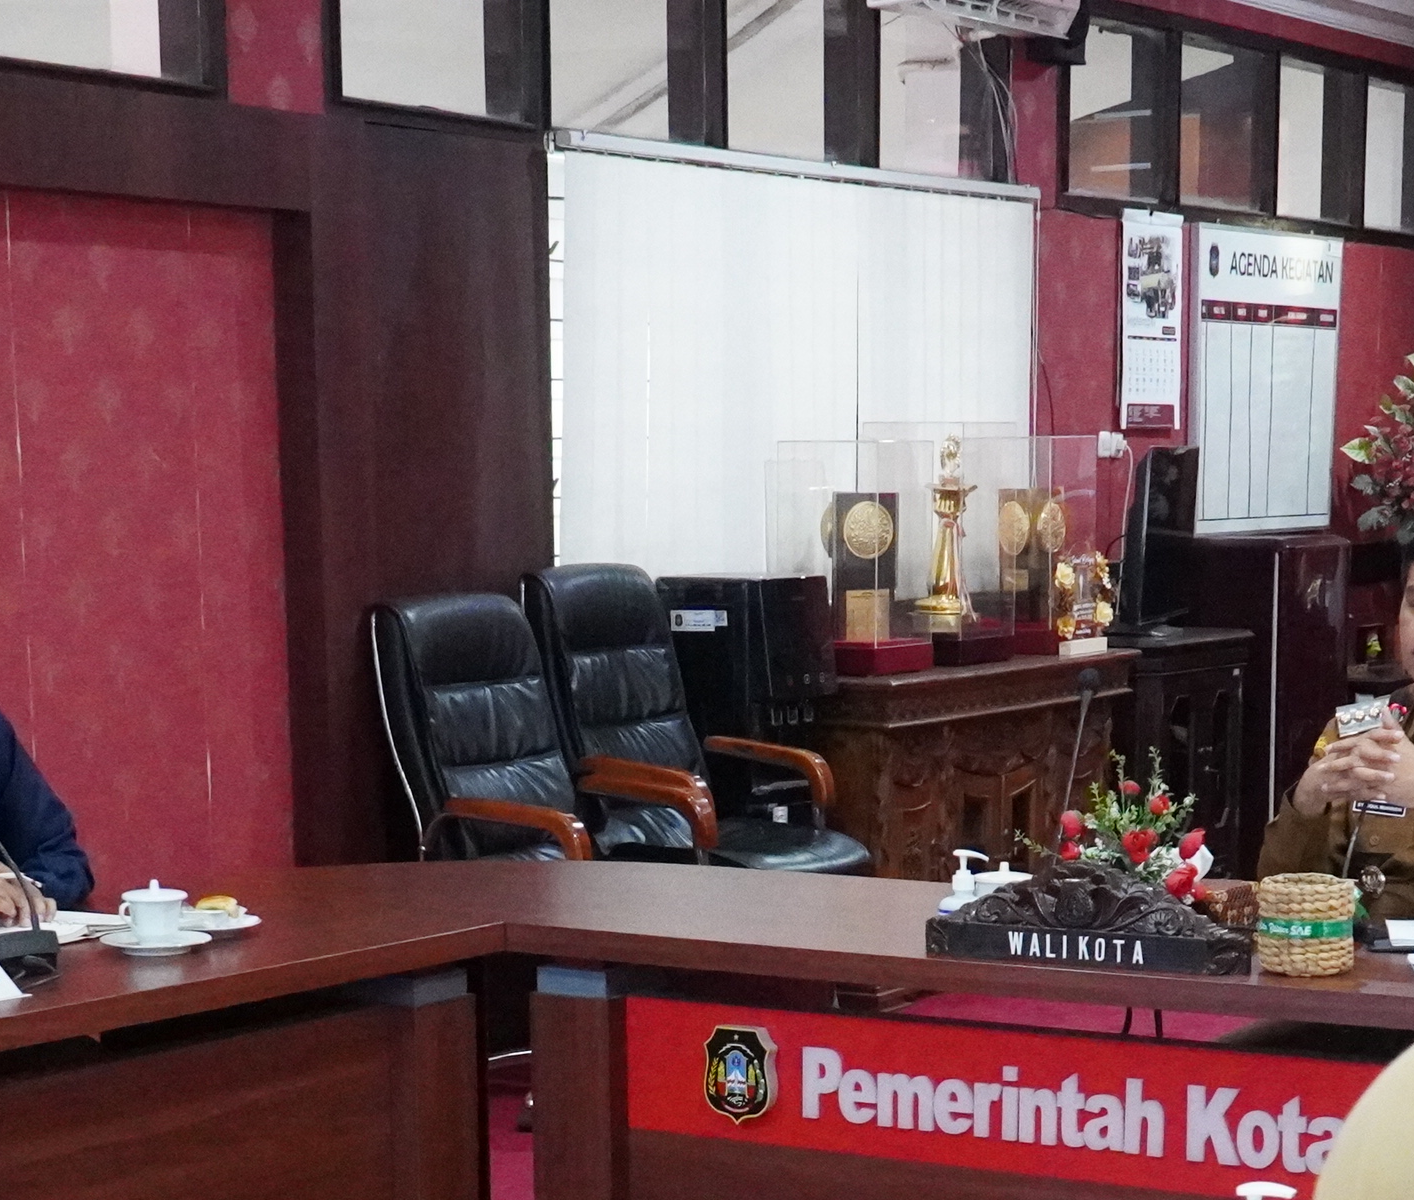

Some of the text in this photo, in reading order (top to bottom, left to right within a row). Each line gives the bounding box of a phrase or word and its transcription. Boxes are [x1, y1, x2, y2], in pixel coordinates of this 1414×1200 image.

[1229, 250, 1334, 284] AGENDA KEGIATAN
[801, 1046, 1346, 1175] Pemerintah Kota
